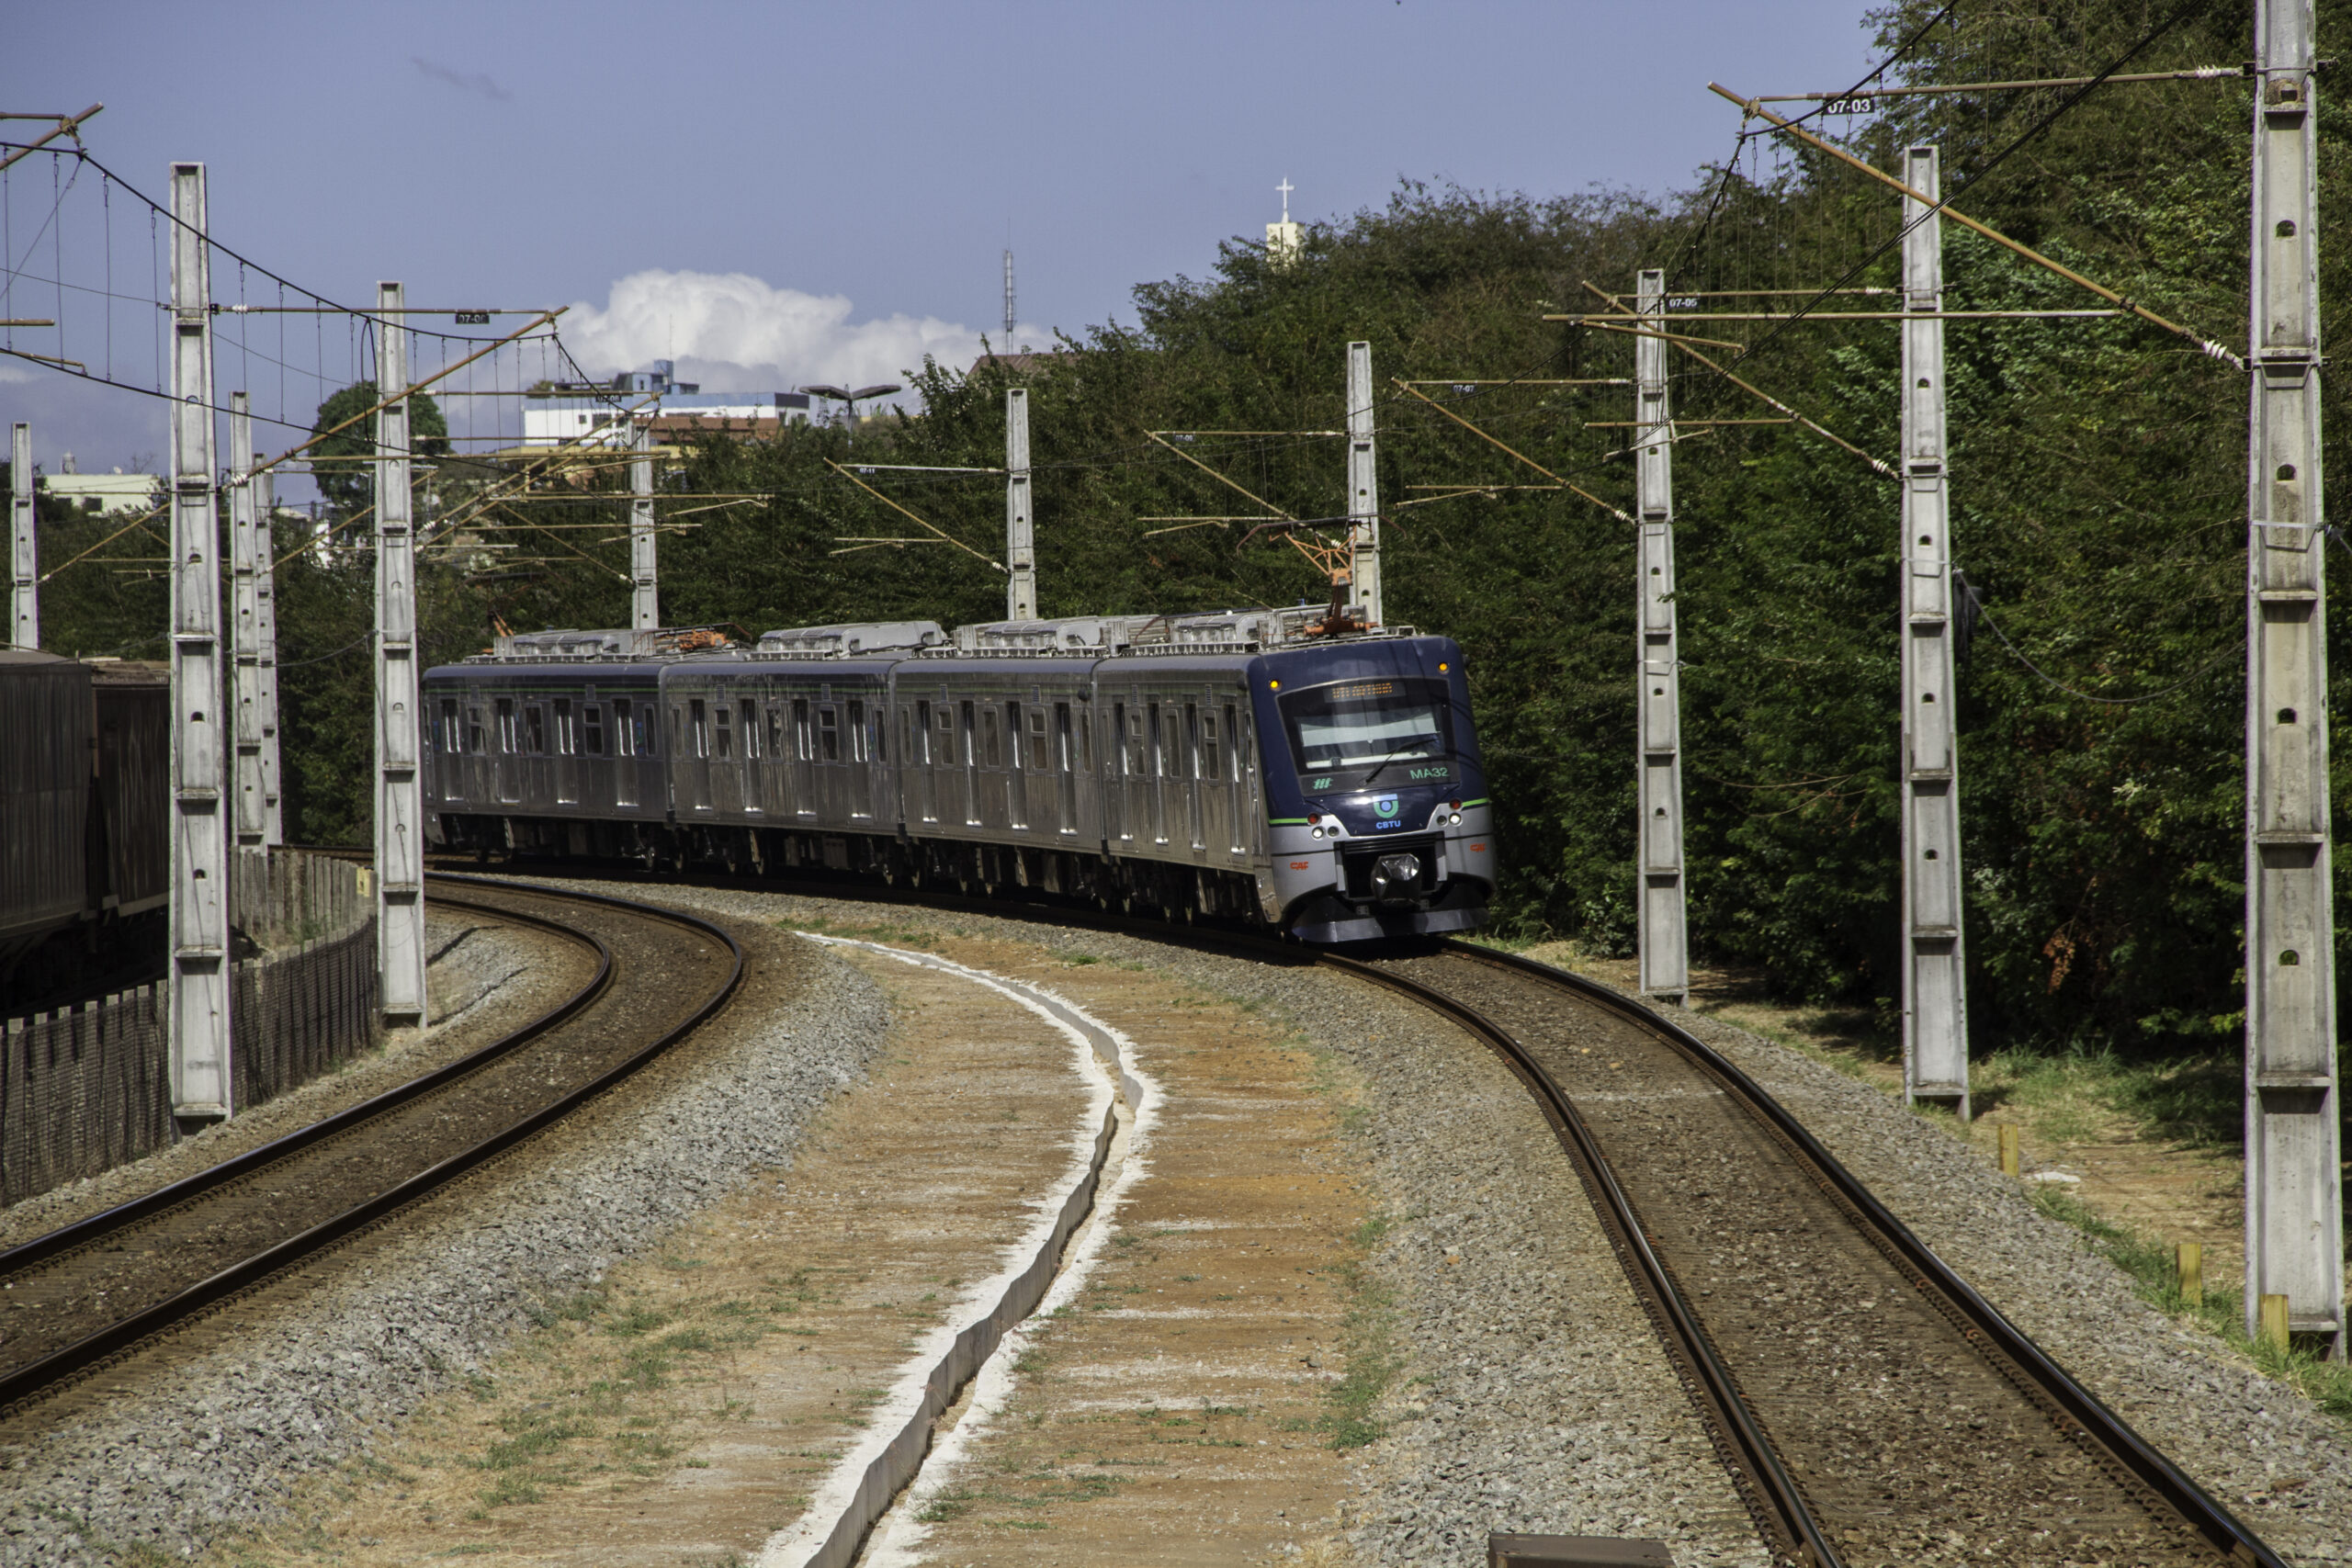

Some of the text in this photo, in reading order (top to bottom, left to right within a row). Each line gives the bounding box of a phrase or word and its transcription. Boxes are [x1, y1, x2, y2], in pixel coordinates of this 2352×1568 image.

[1827, 98, 1871, 114] 07-03
[1668, 298, 1698, 308] 07-05
[1409, 767, 1450, 779] MA32
[1375, 819, 1401, 829] CBTU
[1289, 861, 1309, 870] CAF
